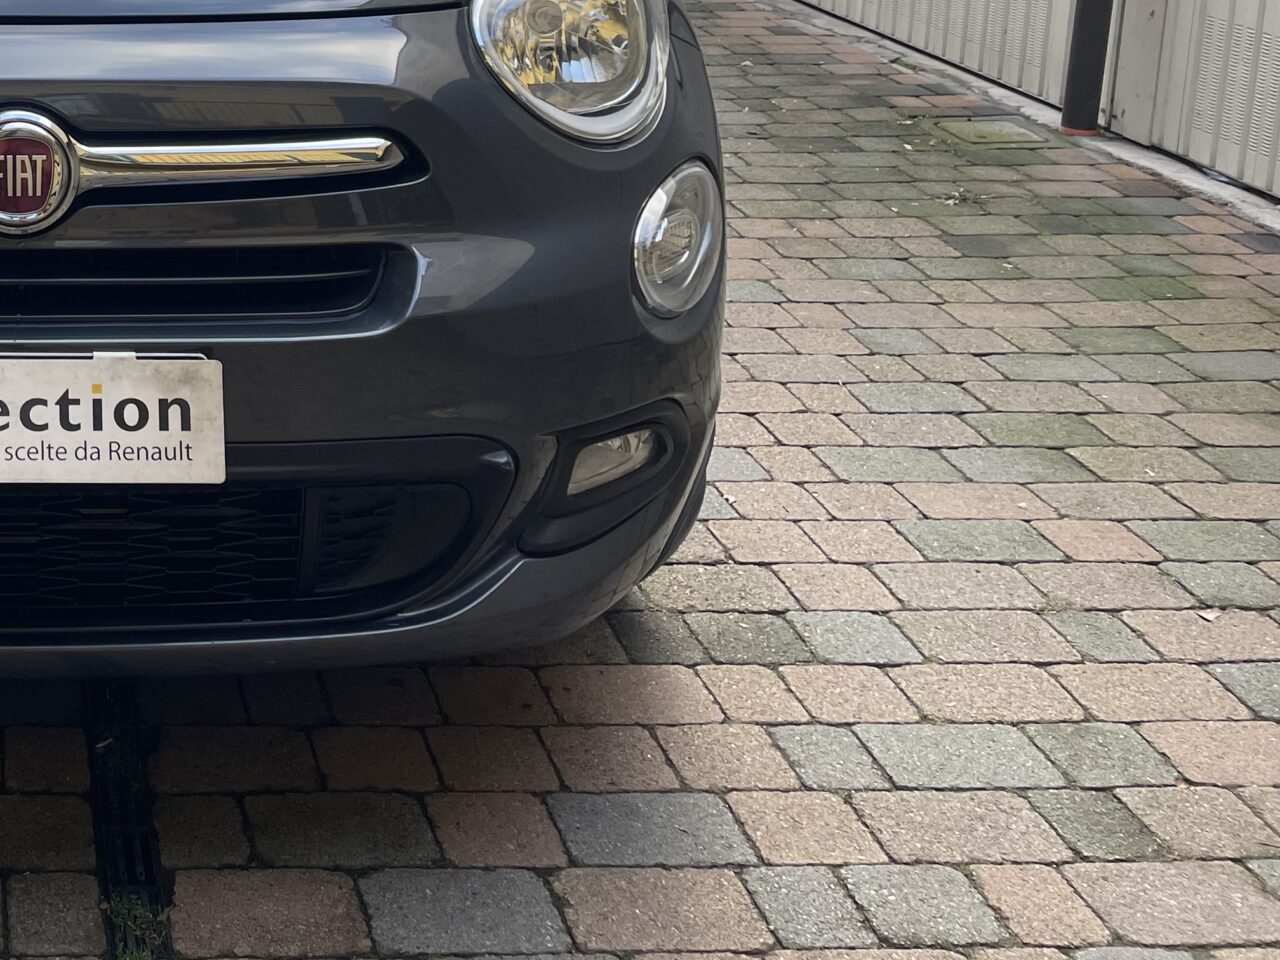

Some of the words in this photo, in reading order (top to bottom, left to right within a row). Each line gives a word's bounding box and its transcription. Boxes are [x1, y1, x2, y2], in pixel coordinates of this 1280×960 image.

[4, 441, 68, 462] scelte
[75, 441, 101, 462] da
[109, 441, 193, 462] Renault
